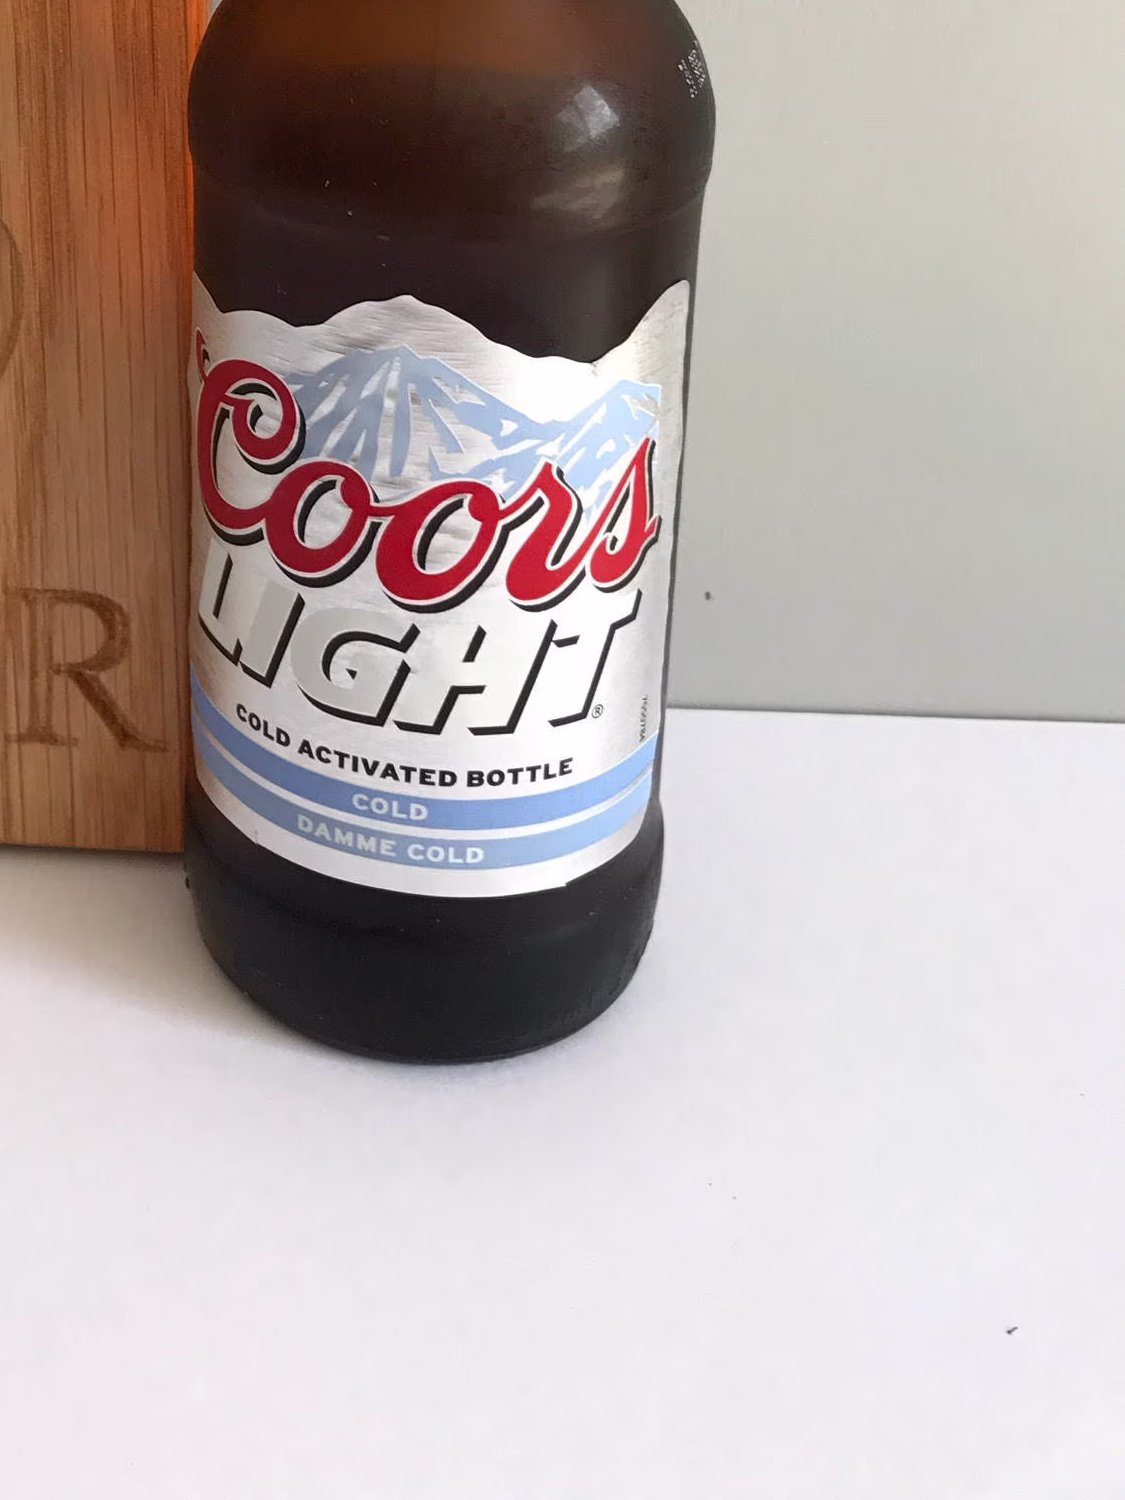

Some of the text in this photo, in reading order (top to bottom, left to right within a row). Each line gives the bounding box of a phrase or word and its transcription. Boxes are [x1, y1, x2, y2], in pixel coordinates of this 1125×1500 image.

[195, 327, 663, 613] Coors
[198, 538, 642, 737] LIGHT
[236, 703, 573, 788] COLD ACTIVATED BOTTLE
[296, 814, 484, 864] DAMME COLD
[352, 793, 428, 821] COLD
